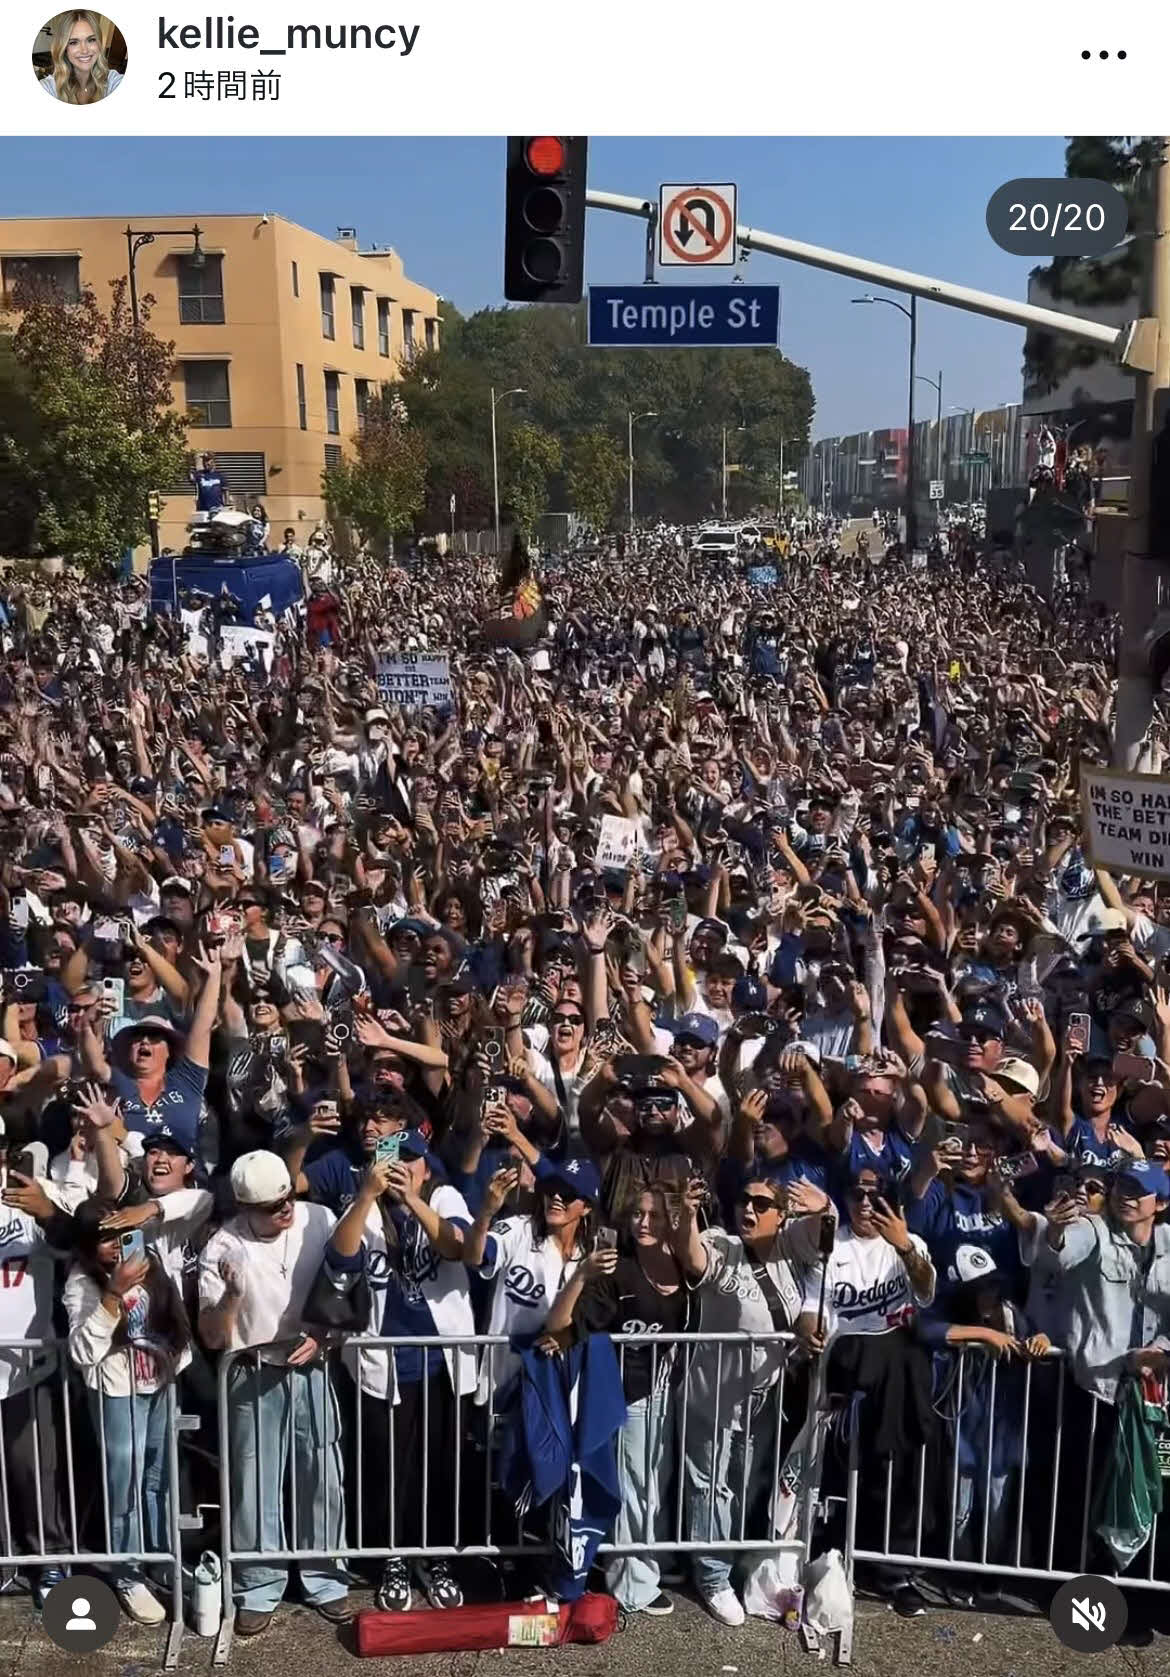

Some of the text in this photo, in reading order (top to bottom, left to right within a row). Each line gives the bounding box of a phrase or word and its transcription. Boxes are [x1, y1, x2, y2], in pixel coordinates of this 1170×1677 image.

[607, 298, 761, 336] Temple St
[400, 652, 418, 665] SO
[377, 673, 430, 687] BETTER
[378, 689, 429, 704] DIDN'T
[1110, 790, 1134, 804] SO
[1141, 793, 1170, 809] HA
[1092, 802, 1122, 820] THE
[1097, 820, 1170, 846] TEAM DI
[1130, 849, 1164, 868] WIN
[2, 1255, 29, 1288] 17
